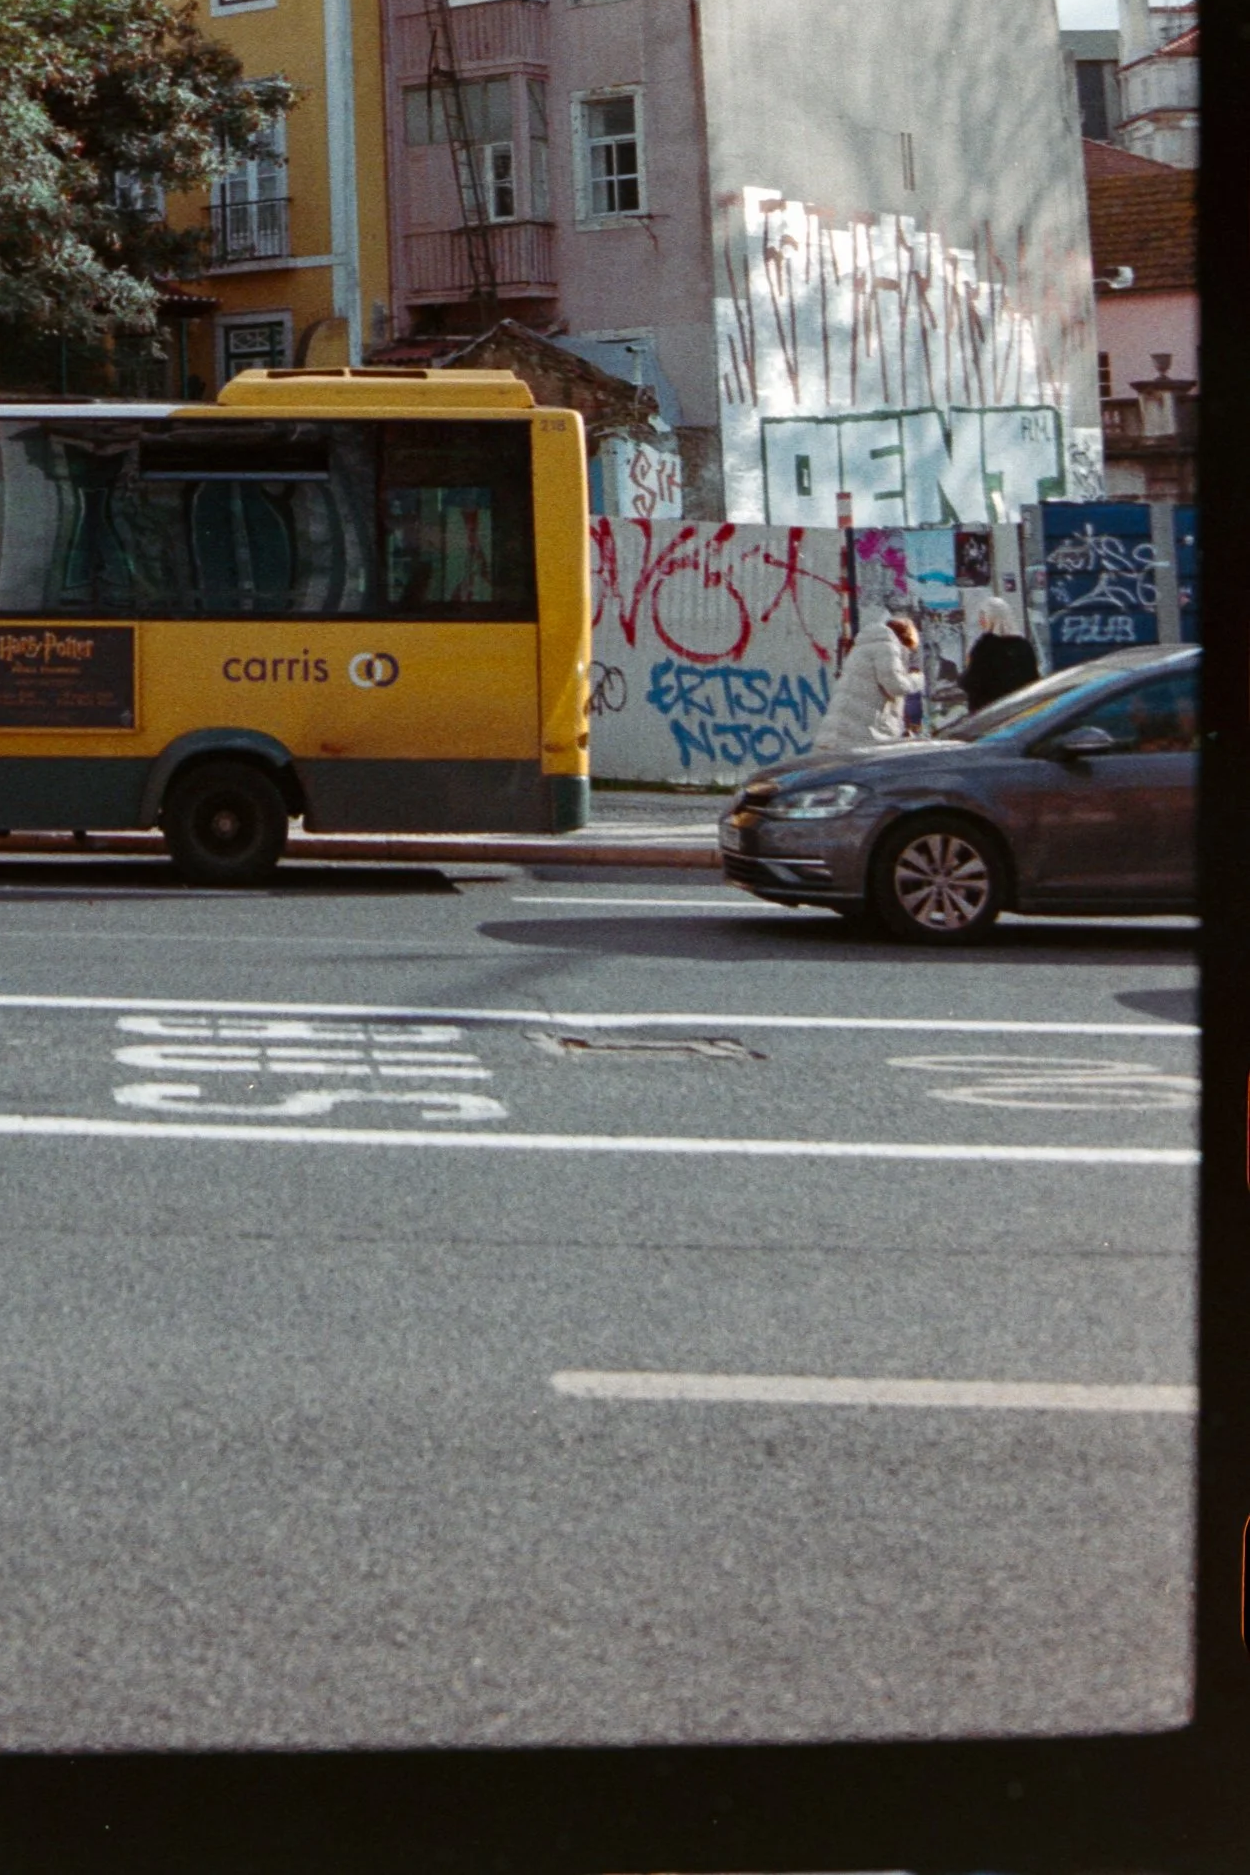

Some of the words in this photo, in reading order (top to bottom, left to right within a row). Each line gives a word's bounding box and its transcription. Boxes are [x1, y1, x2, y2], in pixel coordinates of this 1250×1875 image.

[43, 631, 95, 663] Potter
[223, 648, 329, 683] carris
[112, 1015, 508, 1121] BUS
